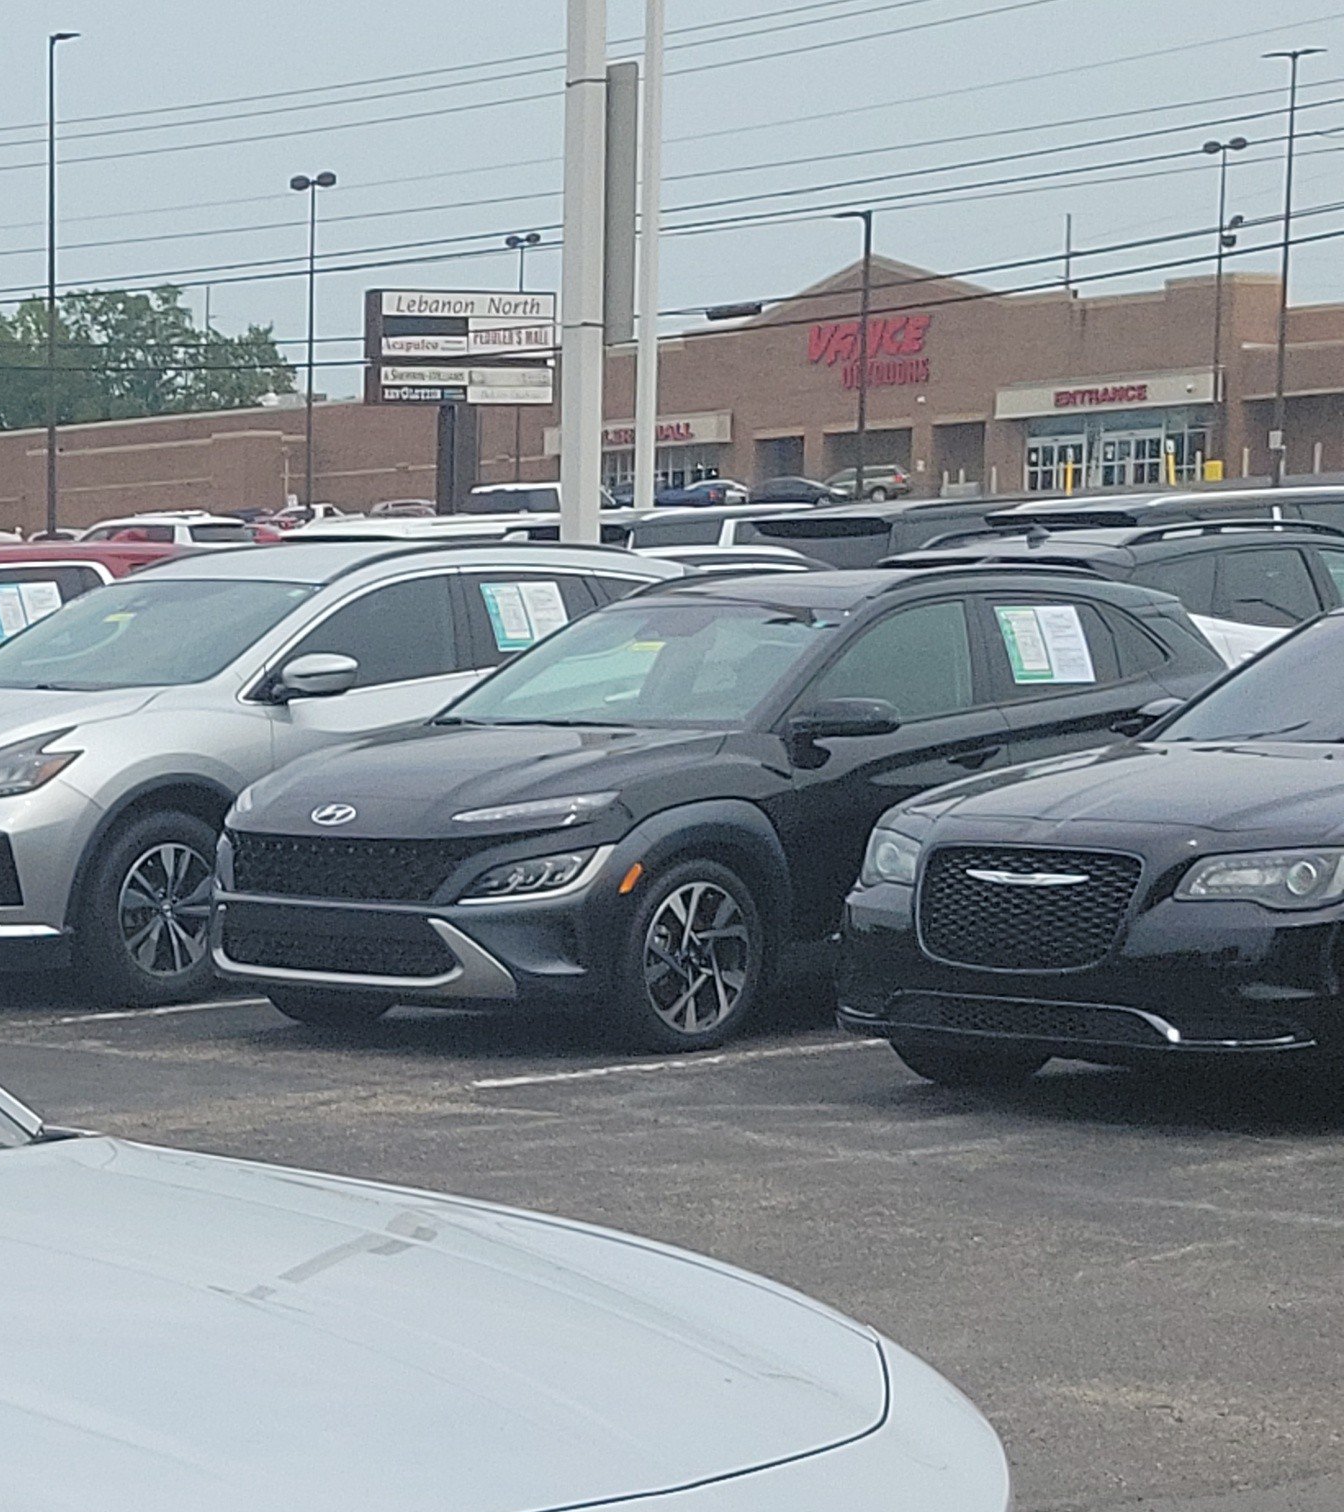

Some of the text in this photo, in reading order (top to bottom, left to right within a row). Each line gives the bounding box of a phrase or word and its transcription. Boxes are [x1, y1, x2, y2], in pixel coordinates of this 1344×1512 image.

[395, 295, 541, 316] Lebanon North
[1054, 384, 1148, 408] ENTRANCE
